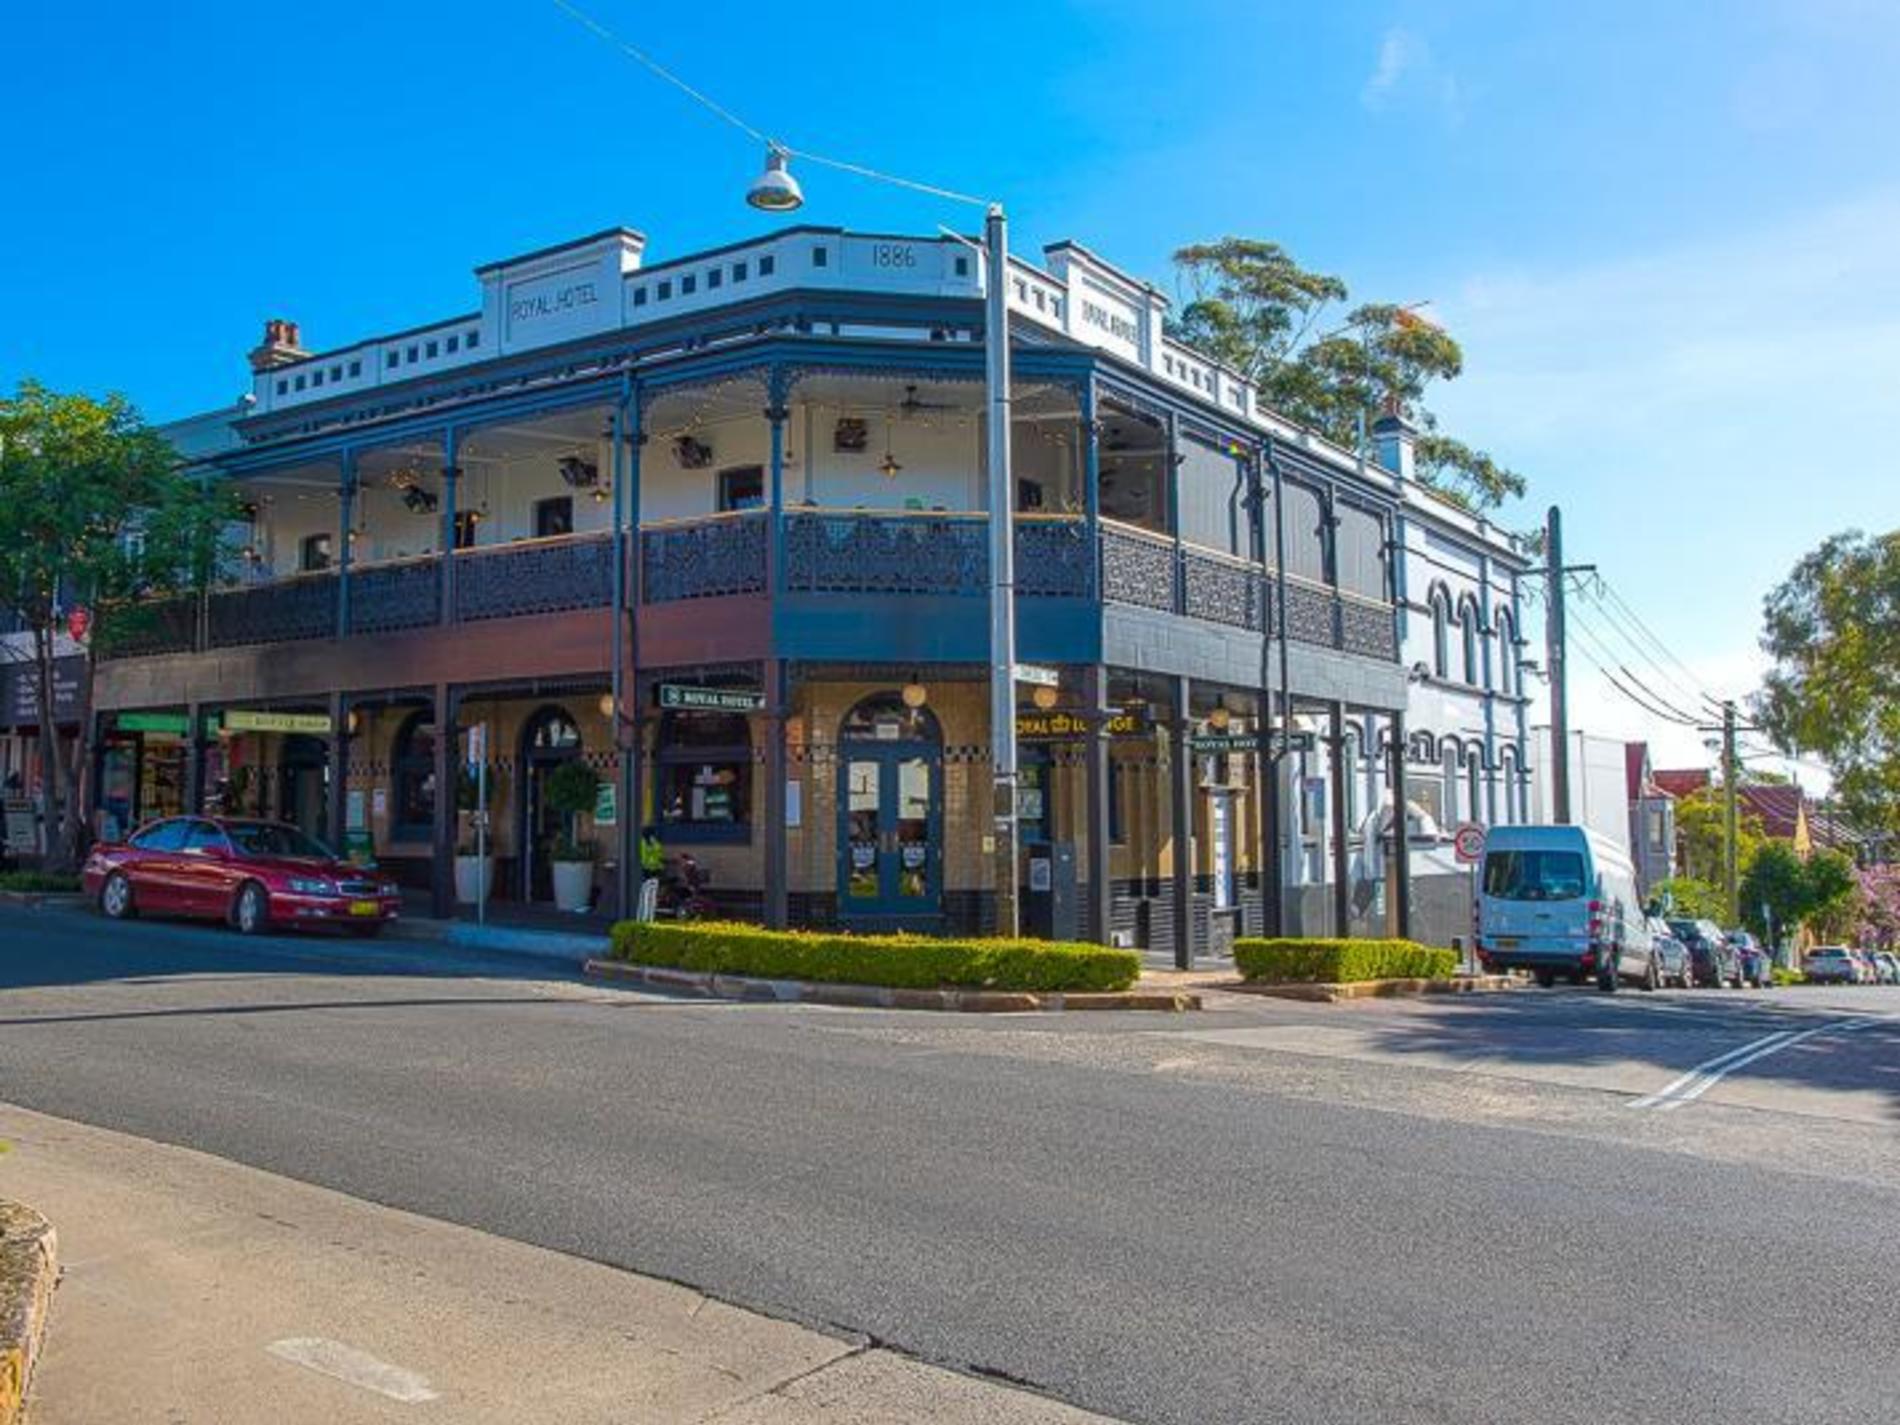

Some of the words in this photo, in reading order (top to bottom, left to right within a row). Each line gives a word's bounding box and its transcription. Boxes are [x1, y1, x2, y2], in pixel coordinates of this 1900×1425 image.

[873, 244, 916, 267] 1886
[512, 297, 551, 320] ROYAL
[556, 283, 598, 310] HOTEL
[684, 692, 719, 705] ROYAL
[1014, 718, 1049, 733] OYAL
